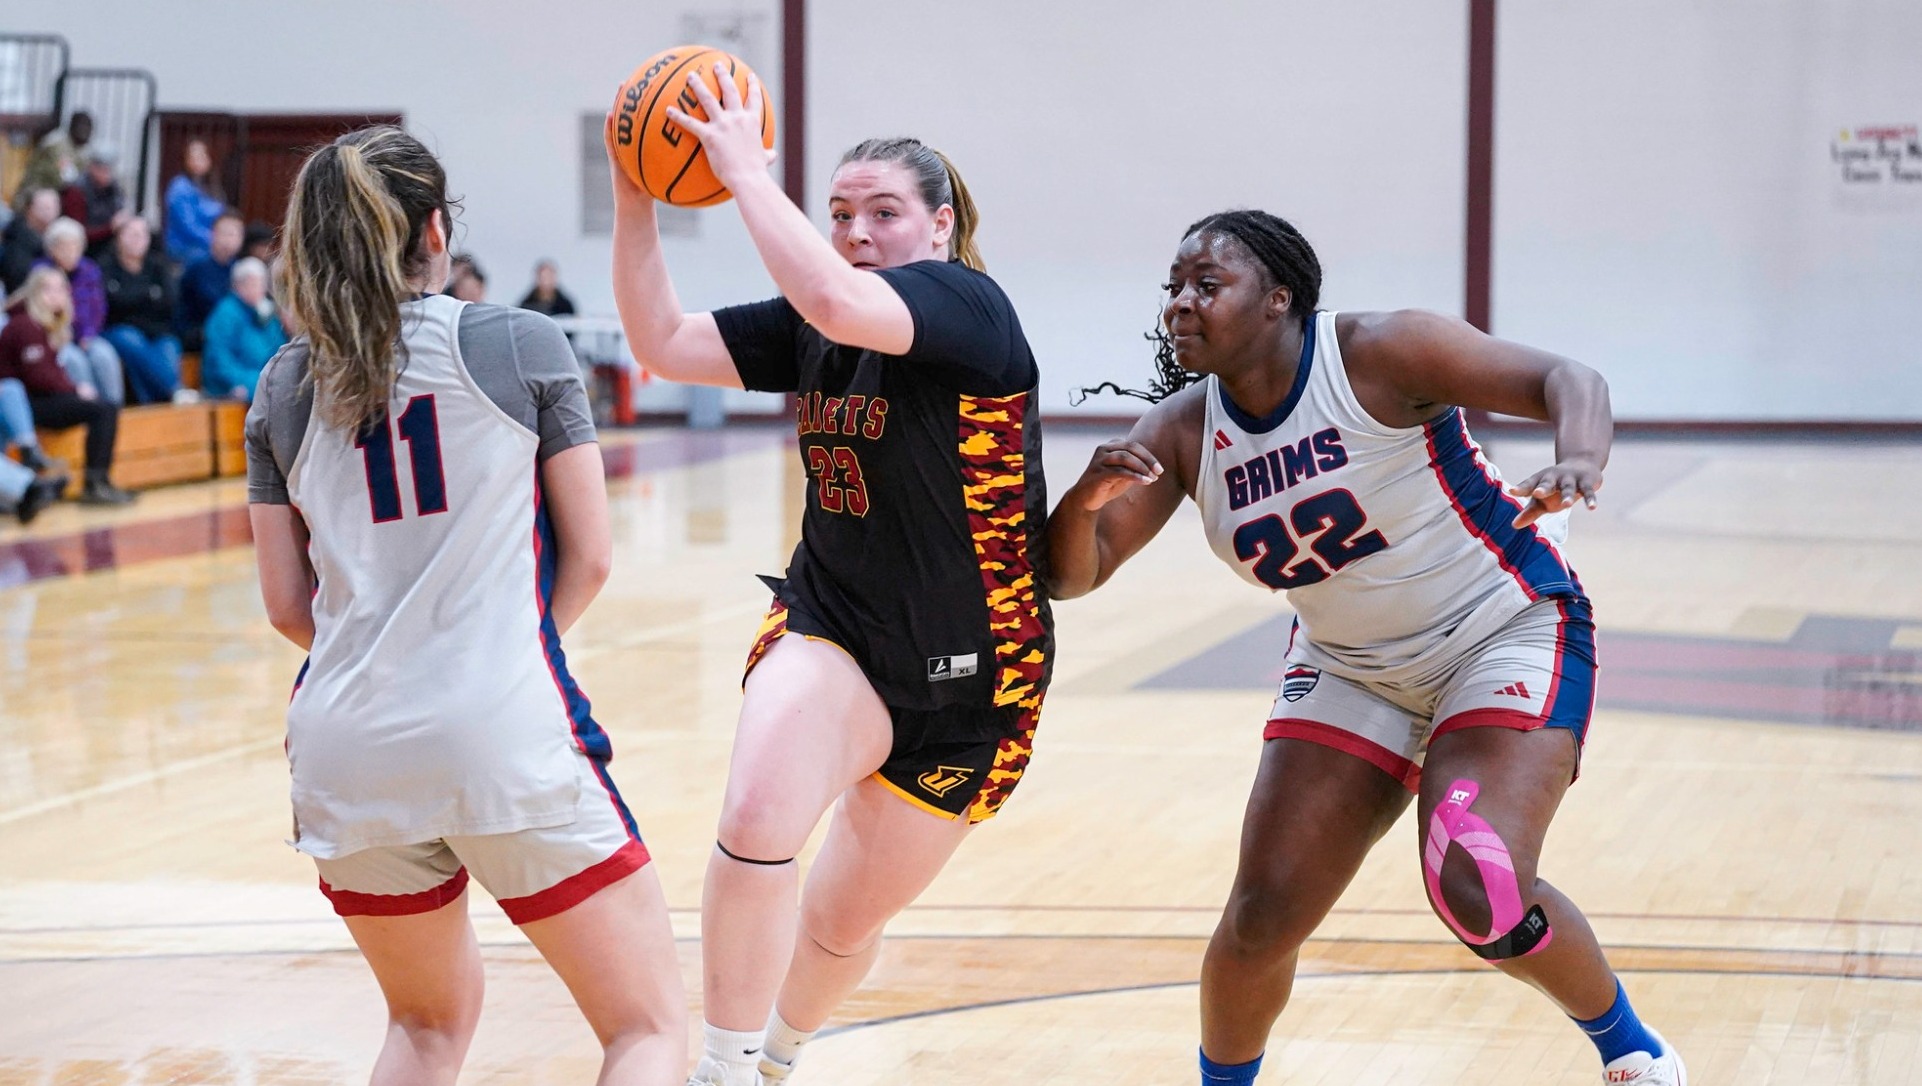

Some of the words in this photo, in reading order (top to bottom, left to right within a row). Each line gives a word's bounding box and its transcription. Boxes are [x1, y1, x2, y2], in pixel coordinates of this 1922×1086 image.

[354, 393, 448, 523] 11
[808, 446, 870, 518] 23
[1224, 427, 1349, 511] GRIMS
[1233, 488, 1389, 590] 22
[959, 667, 971, 676] XL
